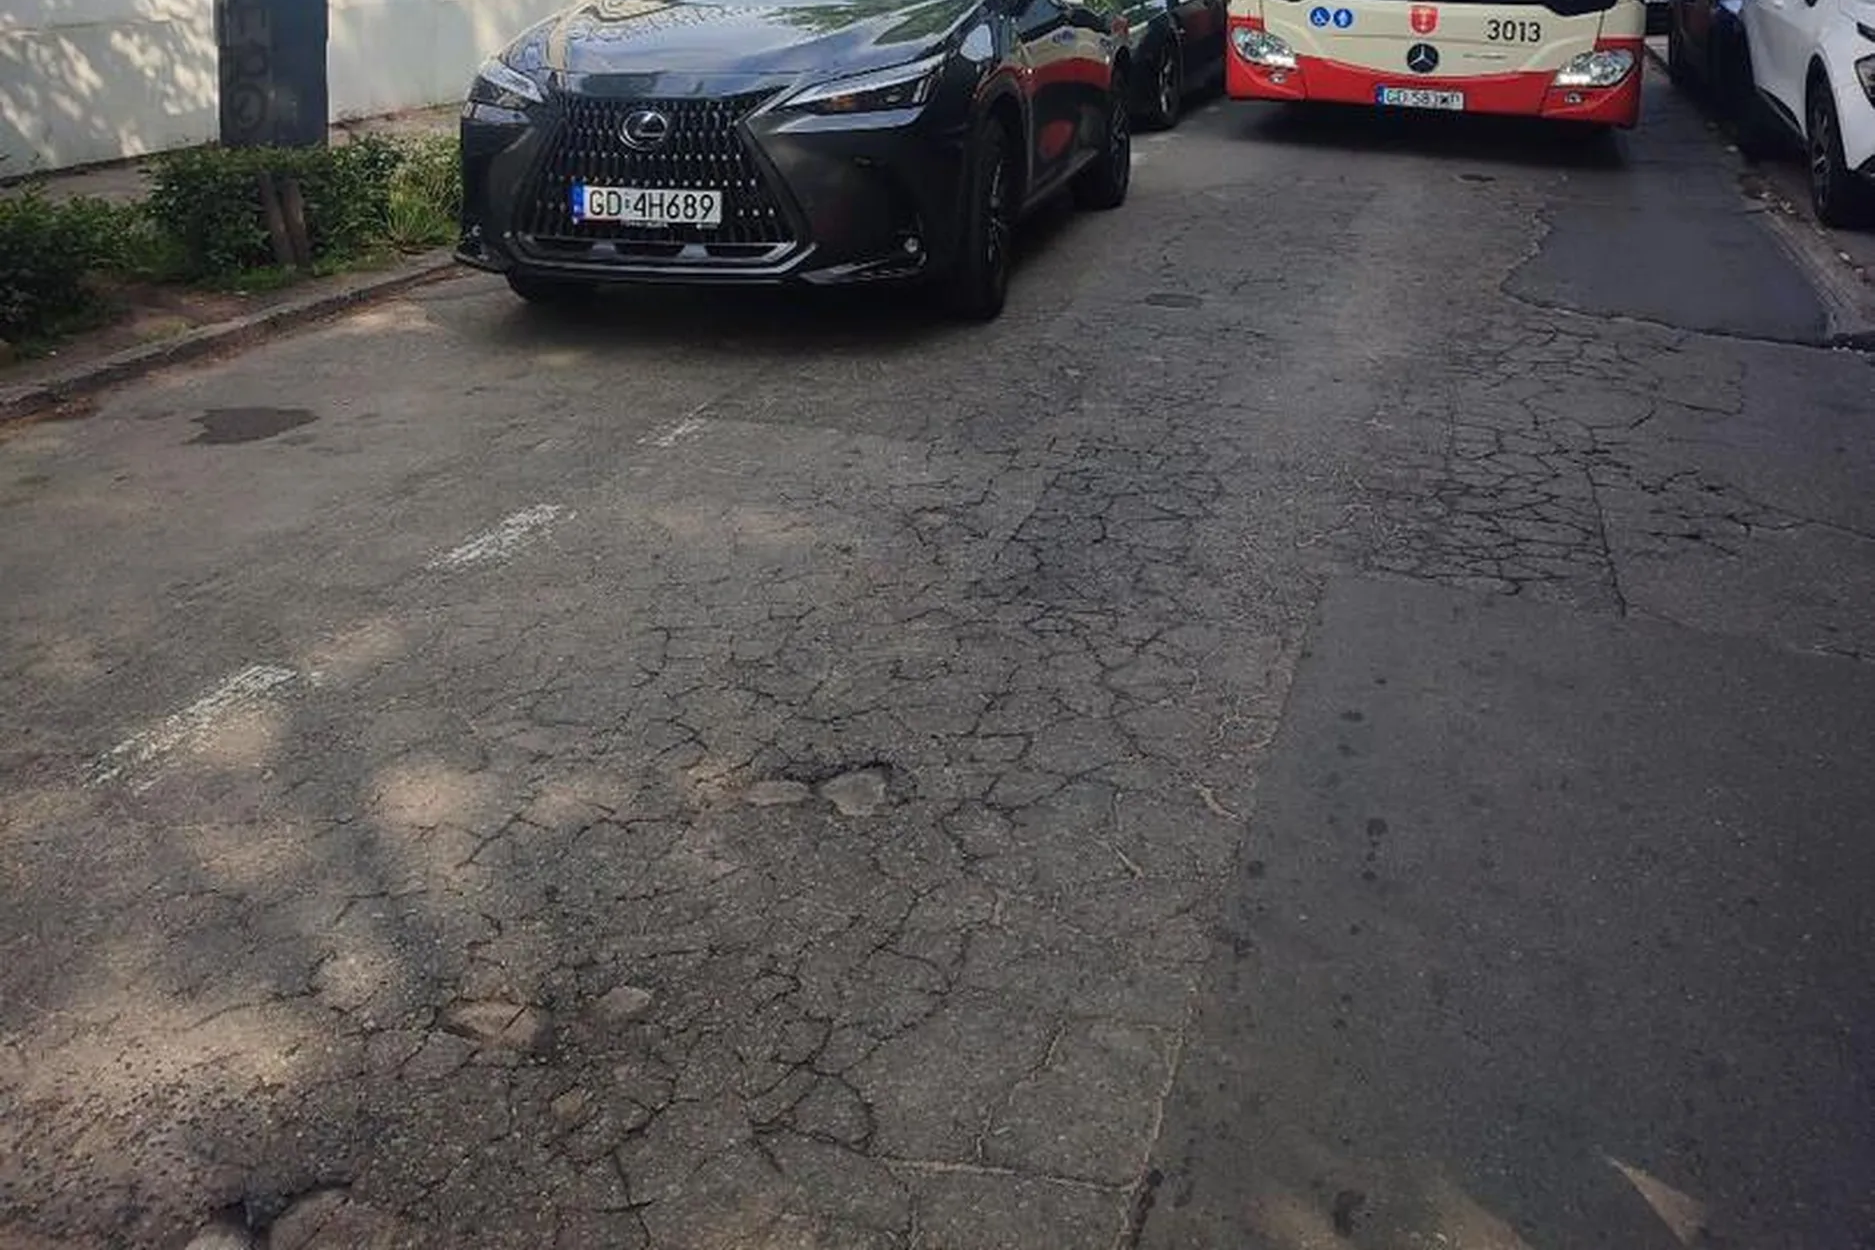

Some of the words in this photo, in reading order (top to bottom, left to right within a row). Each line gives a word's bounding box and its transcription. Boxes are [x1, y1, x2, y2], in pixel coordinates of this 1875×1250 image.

[1487, 19, 1541, 43] 3013
[589, 190, 622, 216] GD
[633, 192, 714, 220] 4H689
